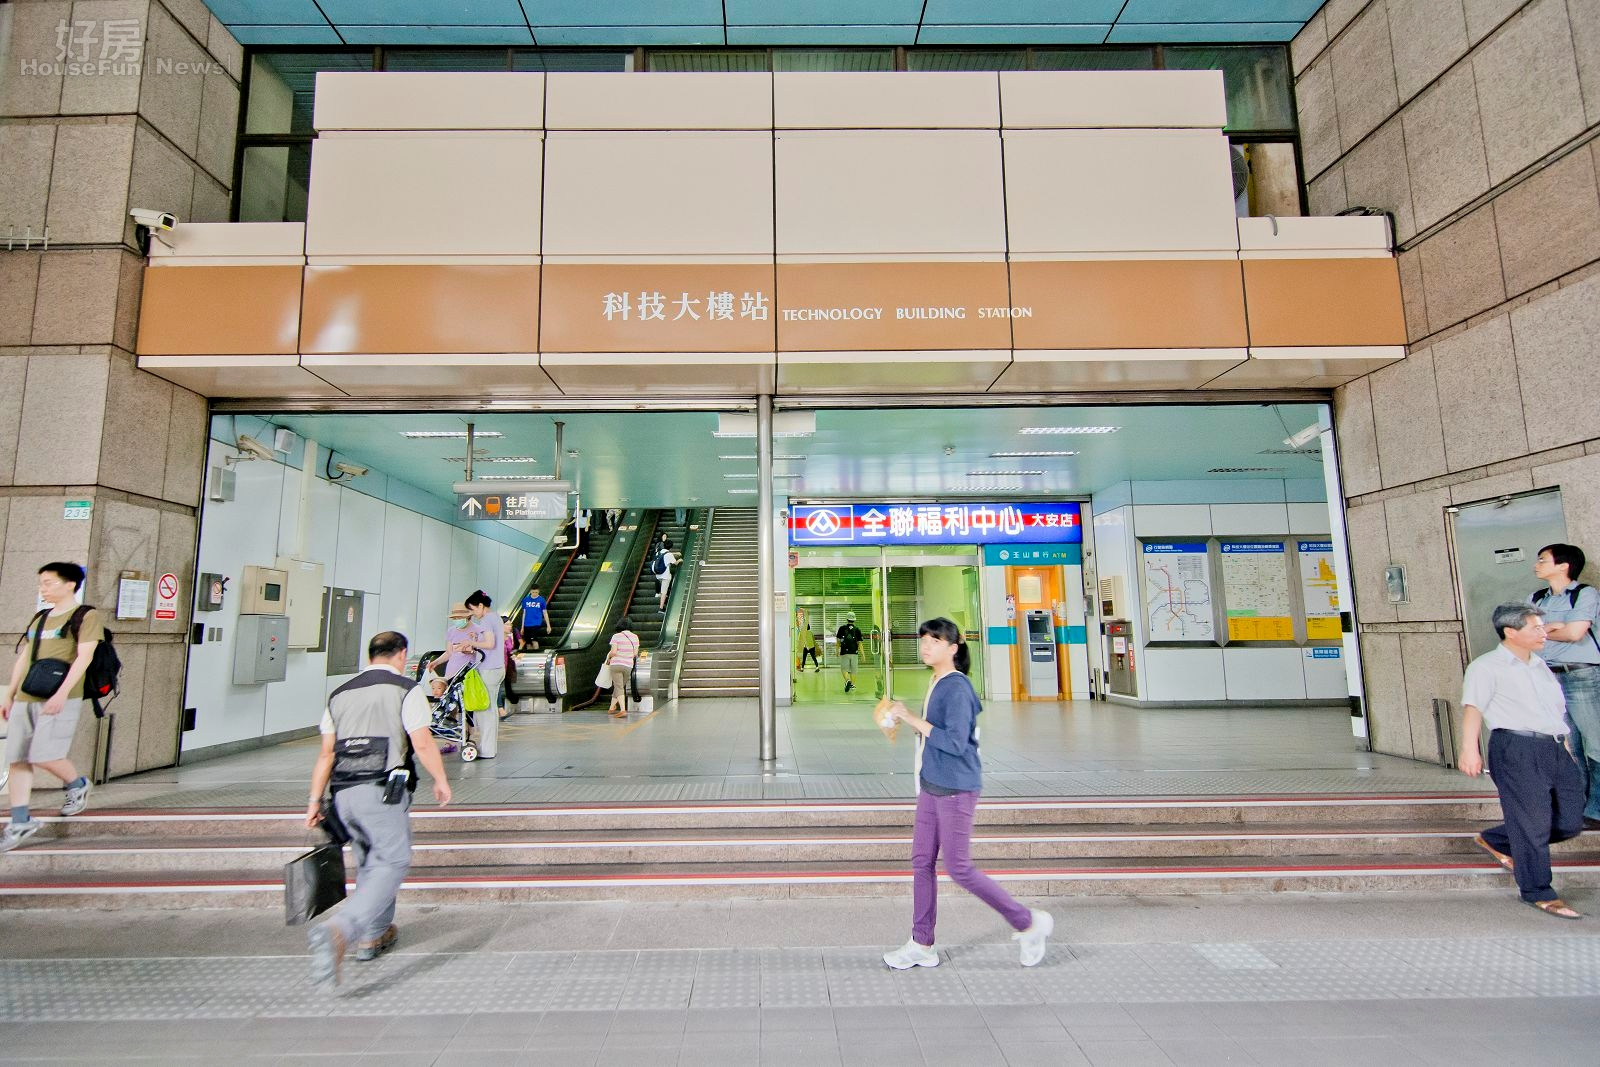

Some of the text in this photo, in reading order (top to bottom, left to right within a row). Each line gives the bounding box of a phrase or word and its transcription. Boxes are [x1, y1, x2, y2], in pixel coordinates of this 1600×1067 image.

[601, 291, 769, 321] 科技大樓站
[782, 306, 1033, 321] TECHNOLOGY BUILDING STATION
[505, 496, 539, 508] 往月台
[860, 505, 1074, 537] 全聯福利中心 大安店
